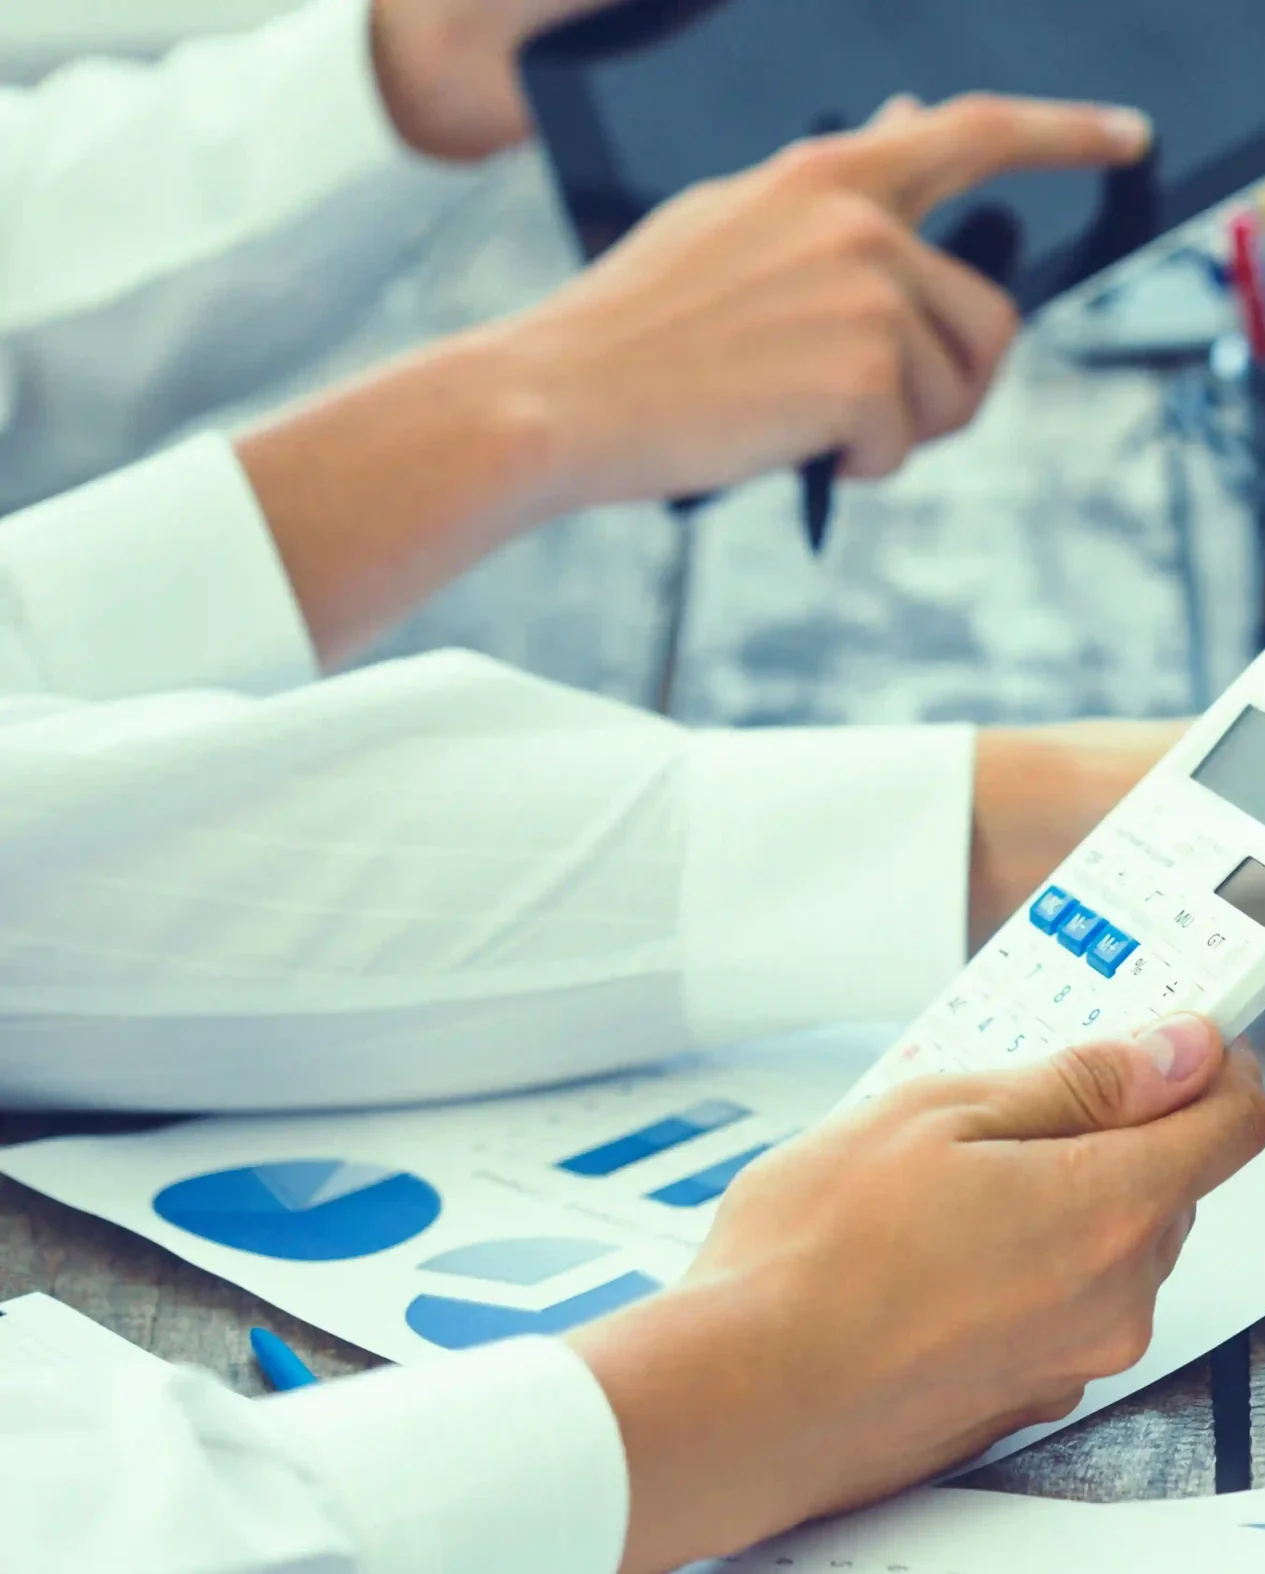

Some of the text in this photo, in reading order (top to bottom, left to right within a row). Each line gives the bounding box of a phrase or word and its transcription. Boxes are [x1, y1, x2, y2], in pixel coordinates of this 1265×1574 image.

[1053, 985, 1071, 1003] 8
[1081, 1008, 1101, 1026] 9
[1006, 1033, 1026, 1053] 5
